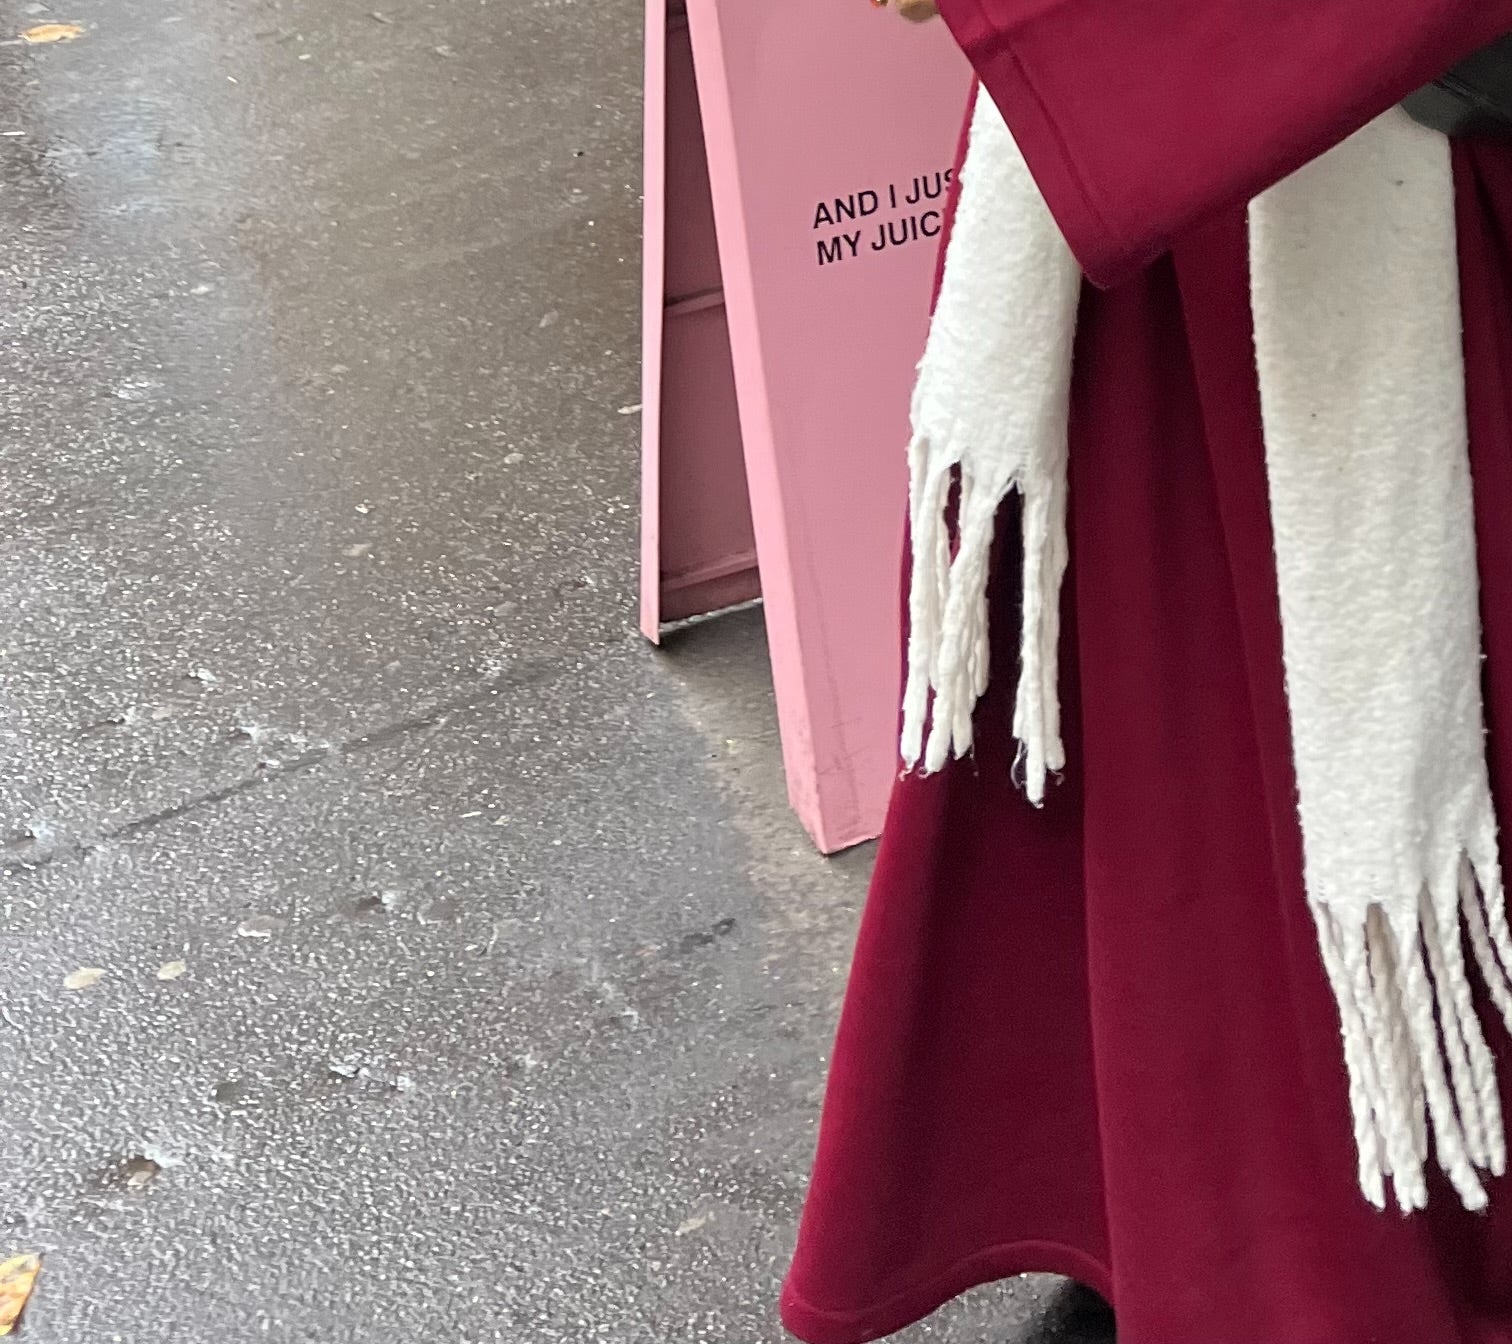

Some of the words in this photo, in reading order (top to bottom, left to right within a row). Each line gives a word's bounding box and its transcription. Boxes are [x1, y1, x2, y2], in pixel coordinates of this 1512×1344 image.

[813, 189, 879, 229] AND
[888, 183, 897, 209] I
[816, 230, 862, 265] MY
[871, 210, 946, 251] JUIC
